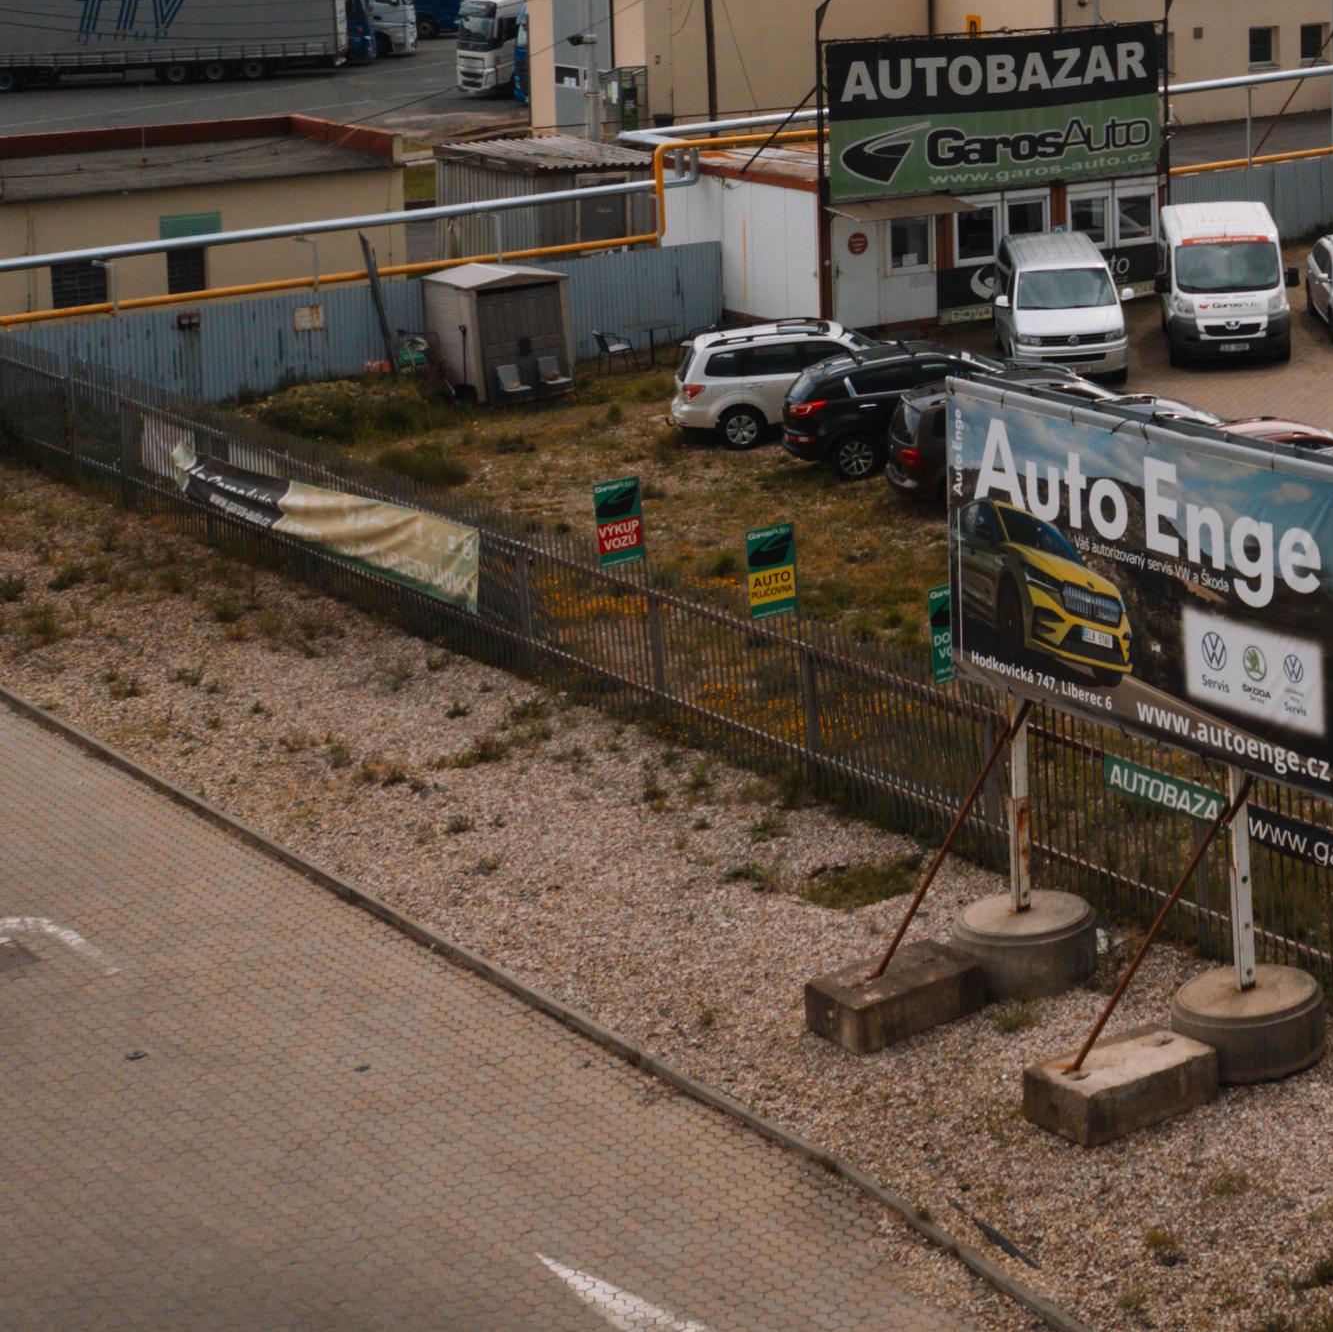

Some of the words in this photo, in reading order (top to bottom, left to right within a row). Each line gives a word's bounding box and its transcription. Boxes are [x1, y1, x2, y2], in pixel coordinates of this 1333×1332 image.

[841, 41, 1148, 102] AUTOBAZAR
[925, 117, 1151, 169] GarosAuto
[928, 151, 1153, 186] www.garos-auto.cz
[951, 306, 992, 323] DOVO
[952, 408, 964, 447] Enge
[952, 447, 964, 497] Auto
[598, 519, 640, 539] VÝKUP
[974, 418, 1129, 541] Auto
[1143, 456, 1322, 608] Enge
[603, 533, 637, 550] VOZŮ
[752, 570, 791, 589] AUTO
[1074, 533, 1090, 551] Váš
[1091, 541, 1145, 570] autorizovaný
[1147, 555, 1174, 574] servis
[1173, 564, 1192, 580] VW
[1192, 572, 1199, 581] a
[1201, 568, 1230, 592] Škoda
[938, 647, 952, 660] VO
[971, 650, 1036, 684] Hodkovická
[1036, 672, 1059, 695] 747,
[1061, 679, 1104, 709] Liberec
[1104, 695, 1113, 711] 6
[1201, 673, 1231, 695] Servis
[1283, 701, 1308, 717] Servis
[1136, 700, 1332, 783] www.autoenge.cz
[1110, 764, 1220, 820] AUTOBAZA
